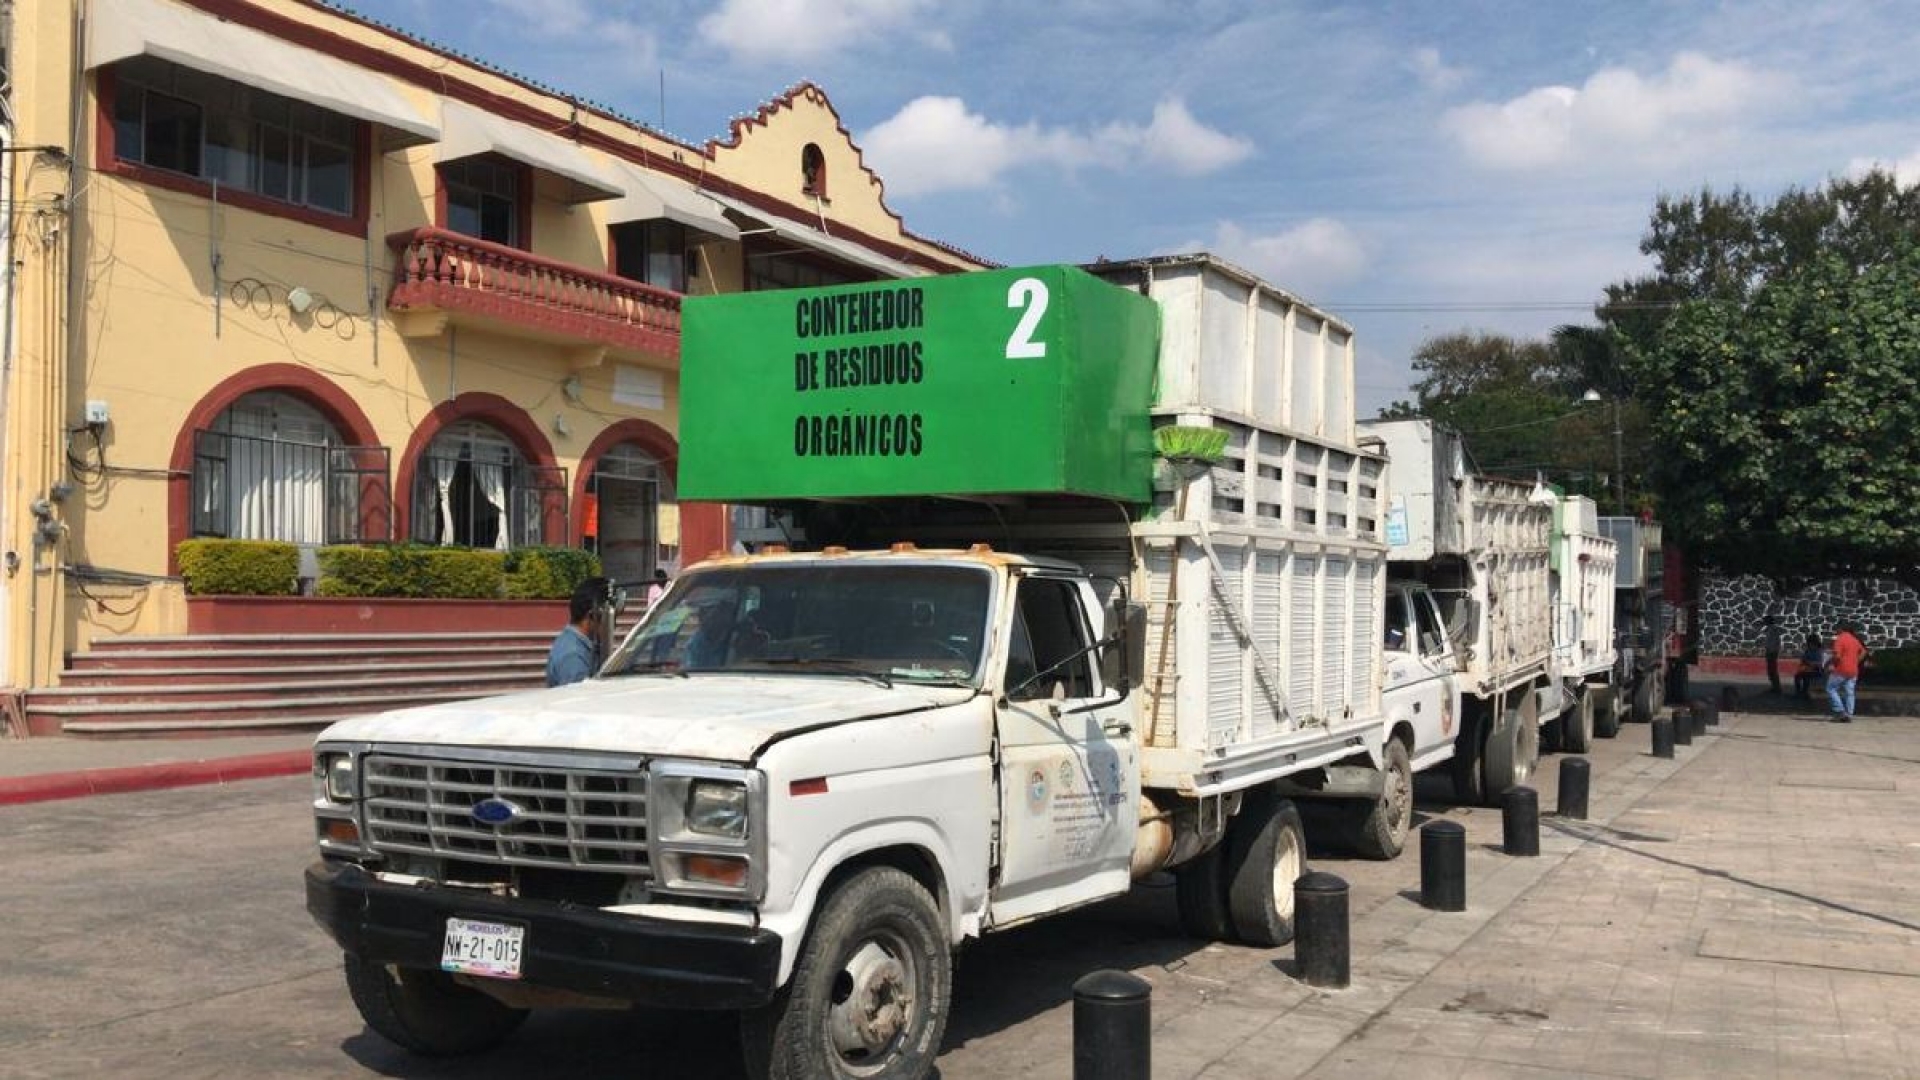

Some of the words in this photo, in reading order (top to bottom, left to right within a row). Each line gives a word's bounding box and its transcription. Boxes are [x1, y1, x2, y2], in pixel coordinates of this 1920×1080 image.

[796, 287, 924, 338] CONTENEDOR
[1006, 277, 1049, 359] 2
[795, 351, 819, 392] DE
[825, 341, 924, 388] RESIDUOS
[795, 408, 923, 456] ORGÁNICOS
